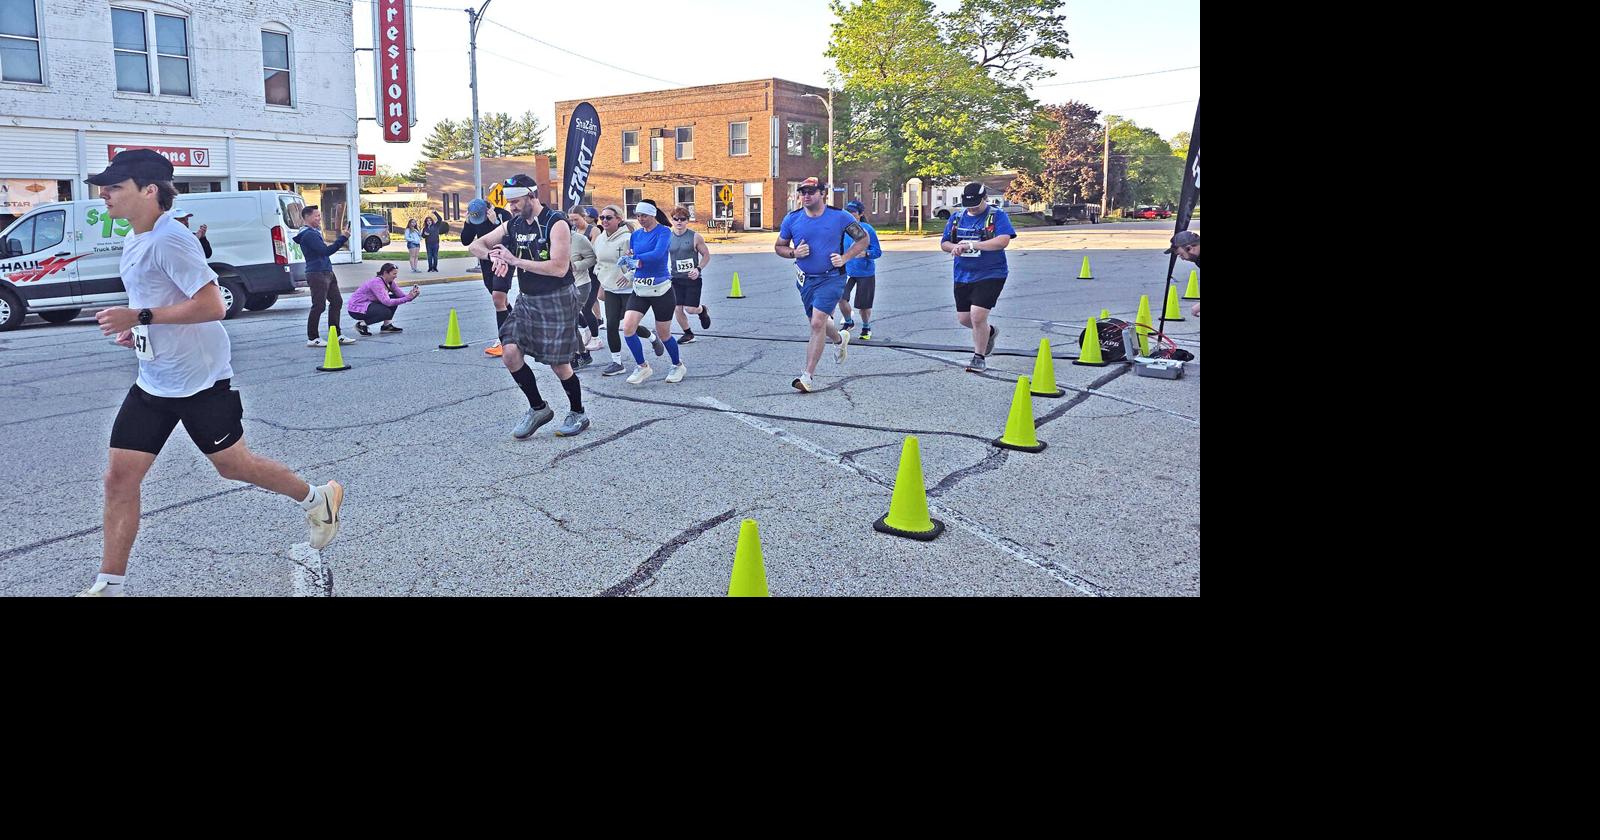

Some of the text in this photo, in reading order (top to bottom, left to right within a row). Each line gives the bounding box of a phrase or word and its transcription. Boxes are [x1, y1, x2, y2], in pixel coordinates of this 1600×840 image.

[386, 0, 403, 136] restone
[568, 137, 593, 206] START
[677, 262, 693, 271] 3253
